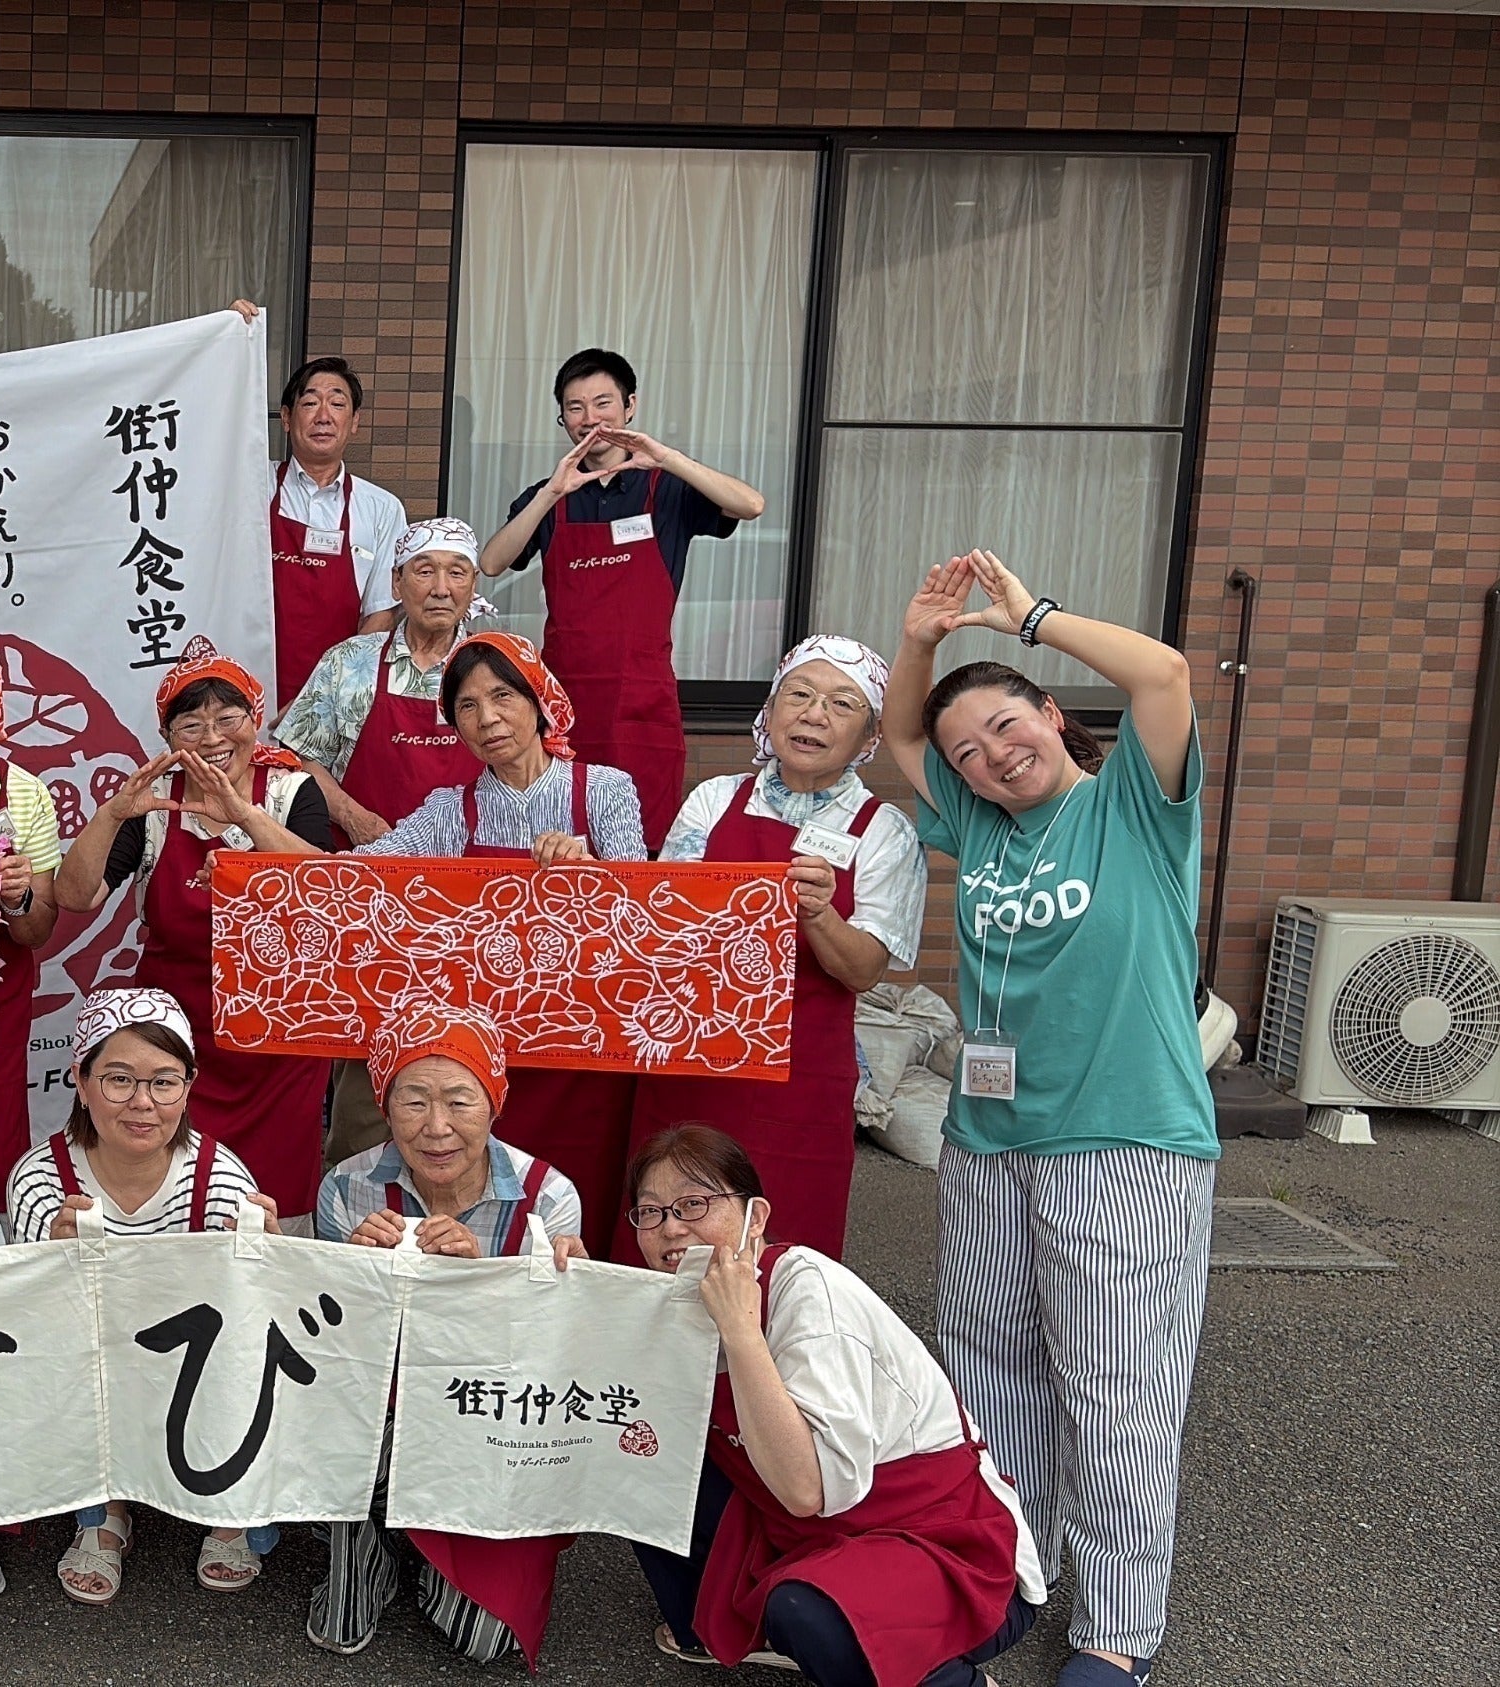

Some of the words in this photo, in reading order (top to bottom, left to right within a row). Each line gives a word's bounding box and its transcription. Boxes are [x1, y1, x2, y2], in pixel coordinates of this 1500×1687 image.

[103, 399, 191, 669] 街仲食堂
[569, 553, 632, 570] ジーバーFOOD
[391, 732, 458, 746] ジーバーFOOD
[974, 879, 1091, 939] FOOD
[444, 1378, 642, 1428] 街仲食堂
[486, 1435, 549, 1450] Machinaka
[550, 1435, 593, 1449] Shokudo
[507, 1457, 518, 1468] by
